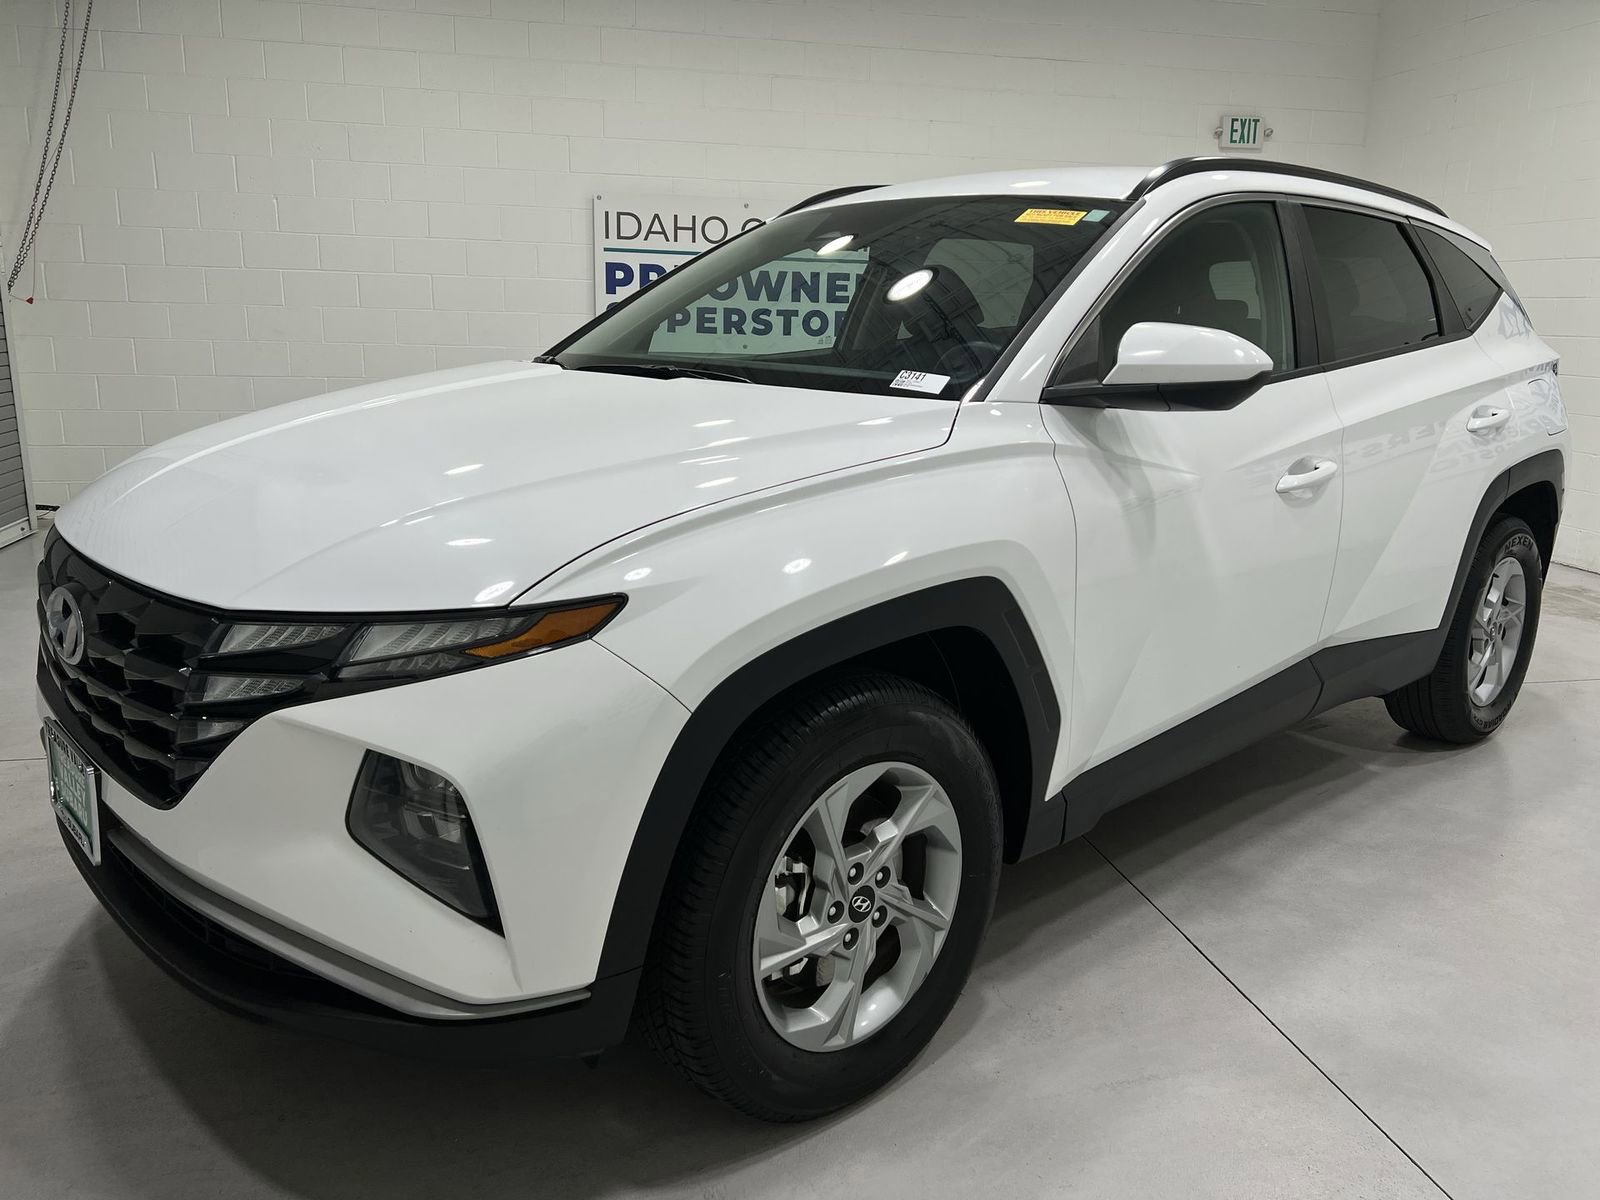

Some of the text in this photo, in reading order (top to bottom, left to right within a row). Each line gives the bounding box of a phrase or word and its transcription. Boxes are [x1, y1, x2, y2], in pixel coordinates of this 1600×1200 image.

[1230, 118, 1260, 144] EXIT
[604, 210, 729, 244] IDAHO
[1504, 535, 1534, 553] NEXEN
